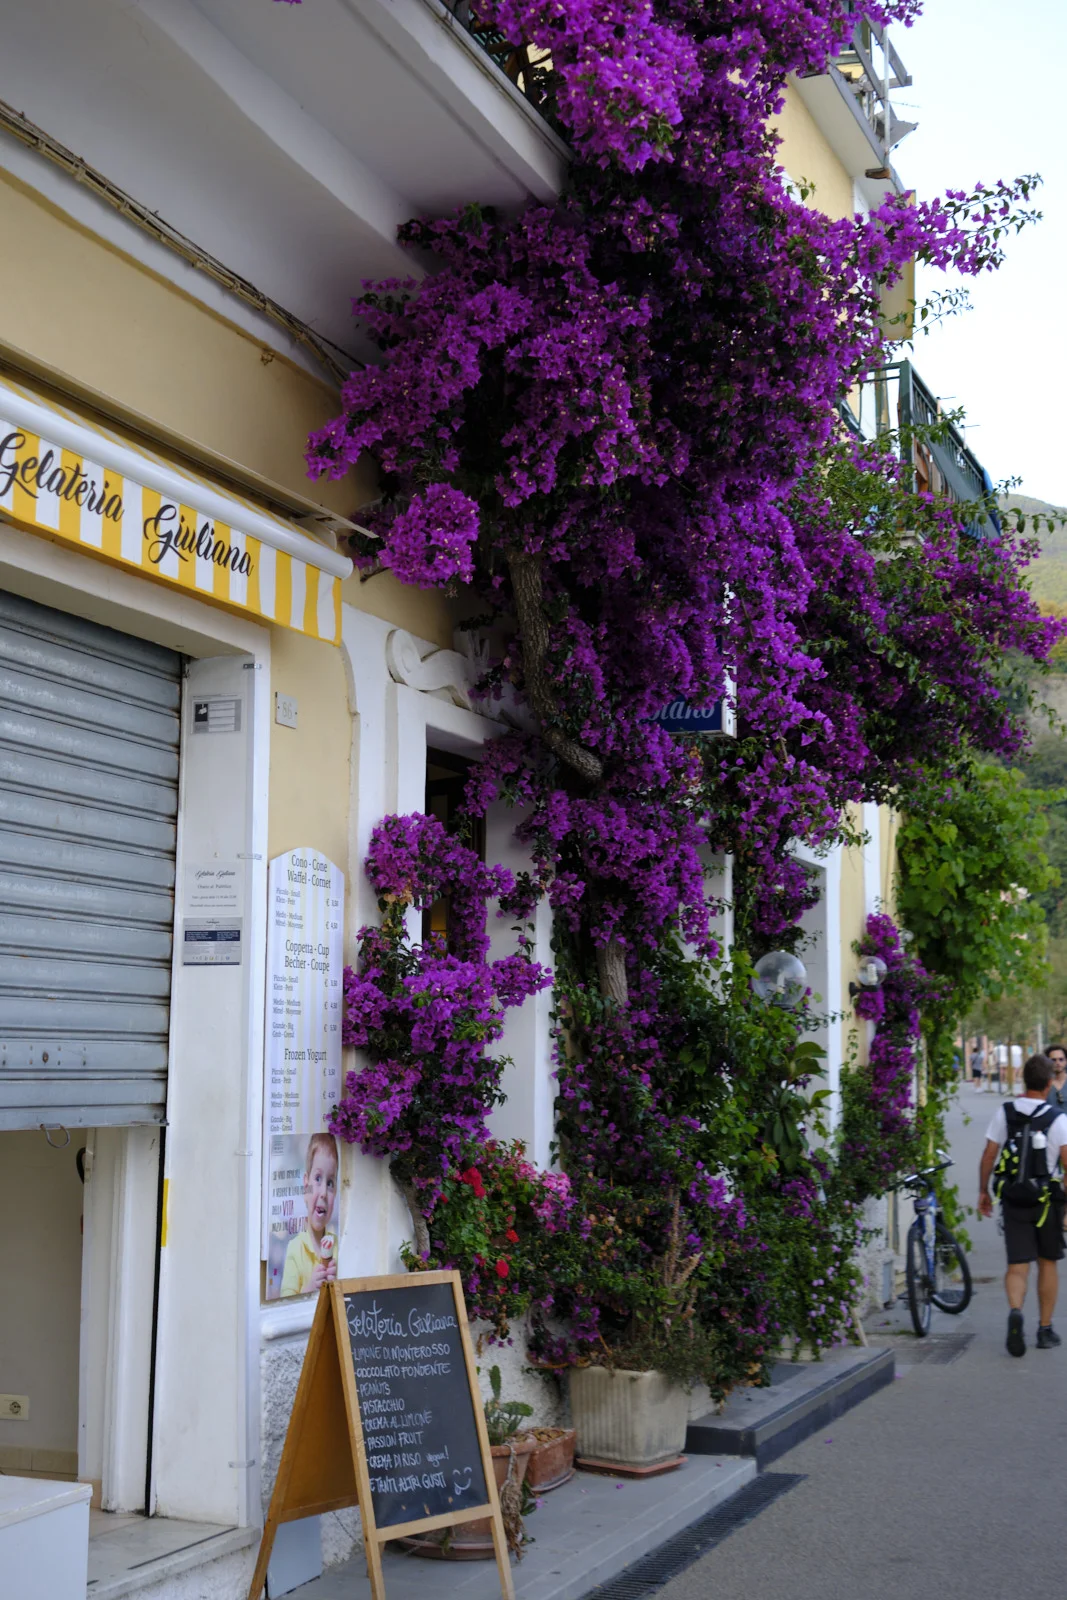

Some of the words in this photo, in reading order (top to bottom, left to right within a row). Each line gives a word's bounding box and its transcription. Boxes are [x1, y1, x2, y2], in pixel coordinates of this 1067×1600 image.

[0, 432, 124, 522] Gelateria
[144, 504, 255, 577] Giuliana
[292, 854, 308, 868] Cono
[312, 858, 327, 872] Cone
[288, 870, 307, 884] Waffel
[312, 874, 331, 888] Cornet
[286, 940, 313, 956] Coppetta
[318, 944, 329, 958] Cup
[285, 956, 306, 969] Becher
[311, 958, 330, 974] Coupe
[285, 1048, 305, 1060] Frozen
[307, 1049, 327, 1063] Yogurt
[346, 1300, 407, 1340] Gelateria
[401, 1360, 451, 1379] FONDENTE
